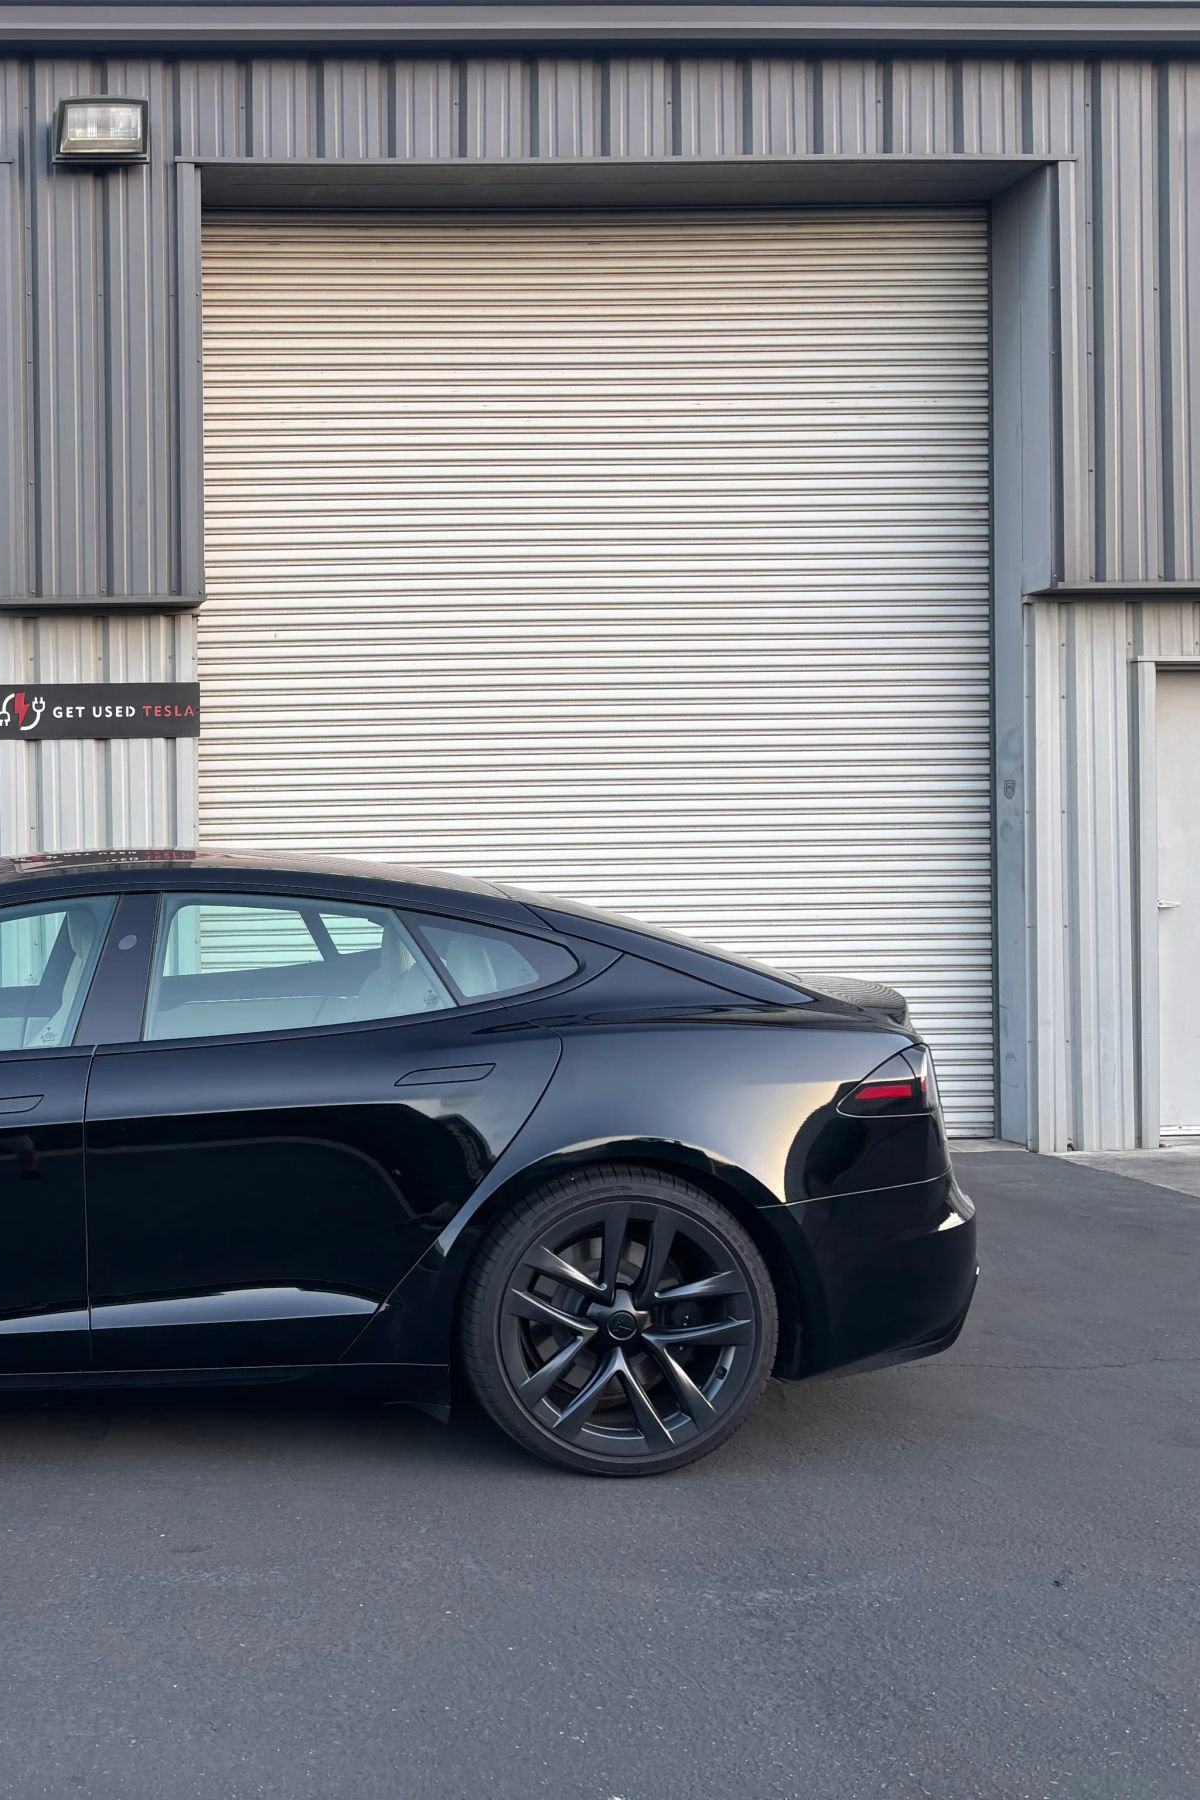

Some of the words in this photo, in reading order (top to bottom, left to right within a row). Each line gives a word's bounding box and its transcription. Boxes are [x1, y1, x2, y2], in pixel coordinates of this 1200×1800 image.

[52, 706, 85, 719] GET
[92, 705, 136, 718] USED
[143, 705, 194, 717] TESLA
